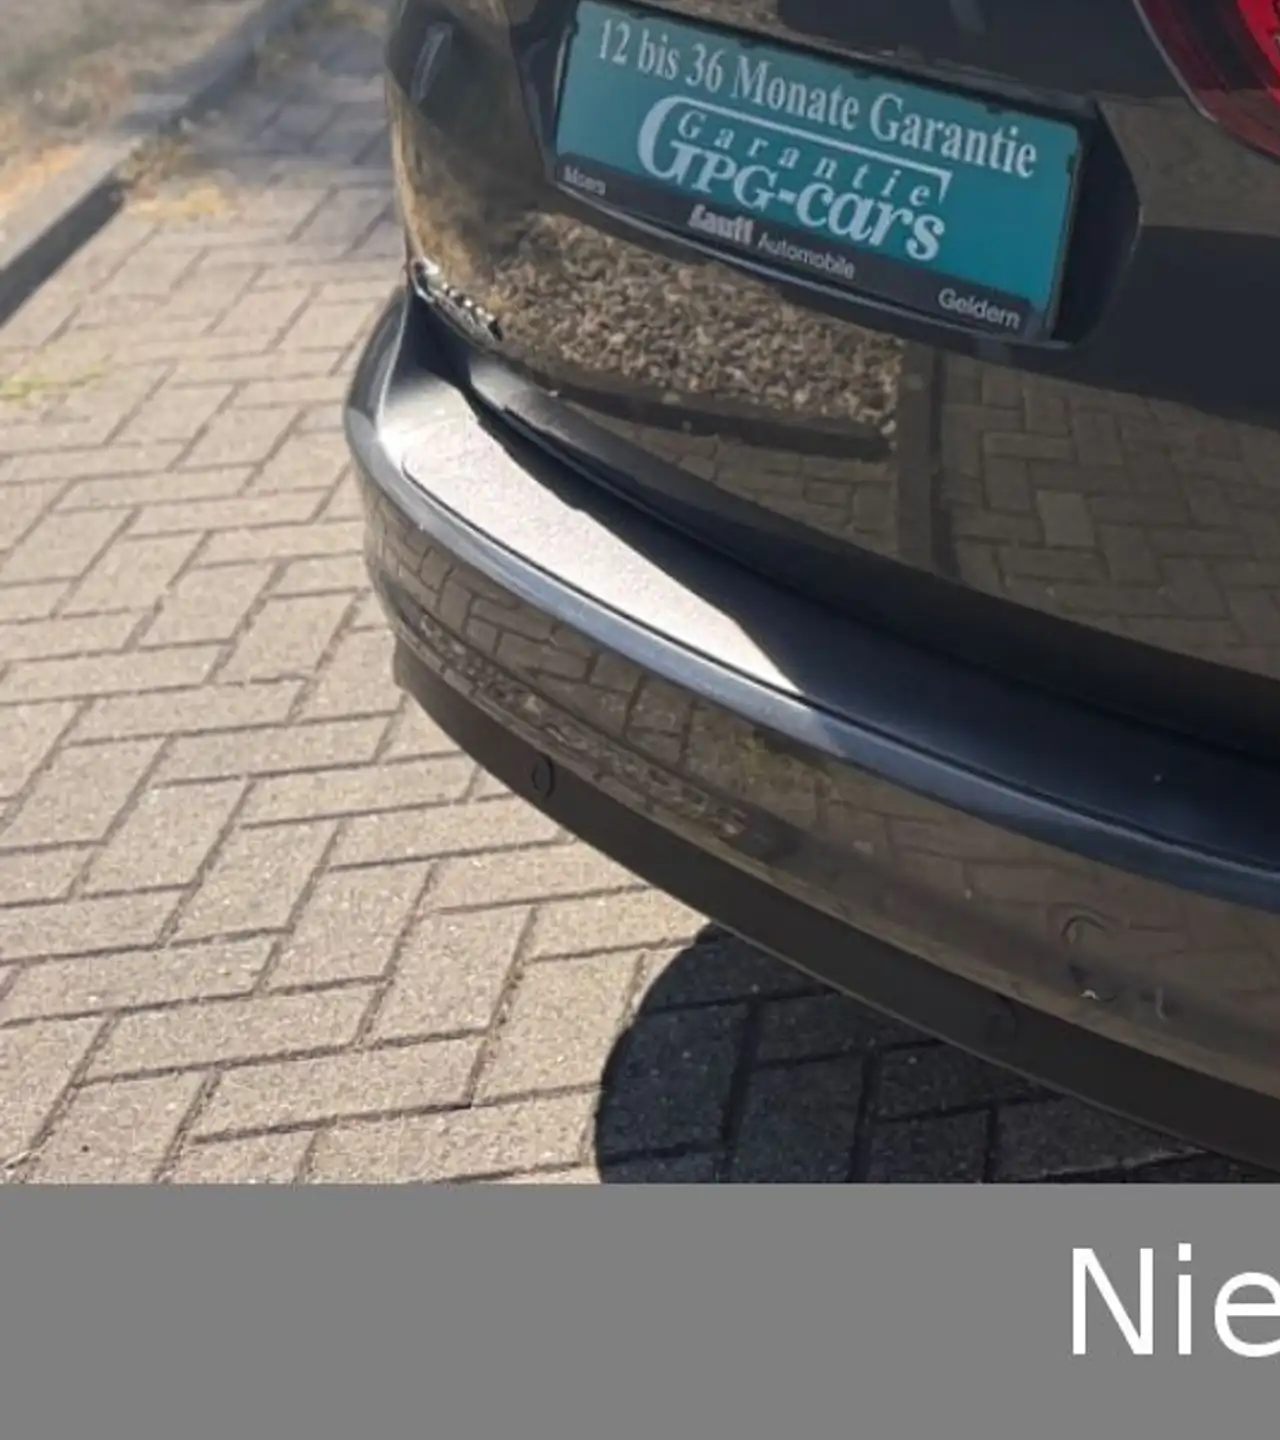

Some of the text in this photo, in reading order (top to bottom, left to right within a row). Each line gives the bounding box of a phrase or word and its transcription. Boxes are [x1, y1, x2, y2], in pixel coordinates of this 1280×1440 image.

[598, 18, 1038, 179] 12 bis 36 Monate Garantie
[637, 95, 947, 262] GPG-cars
[677, 109, 931, 207] Garantie
[758, 232, 856, 280] Automobile
[938, 287, 1021, 330] Geldern
